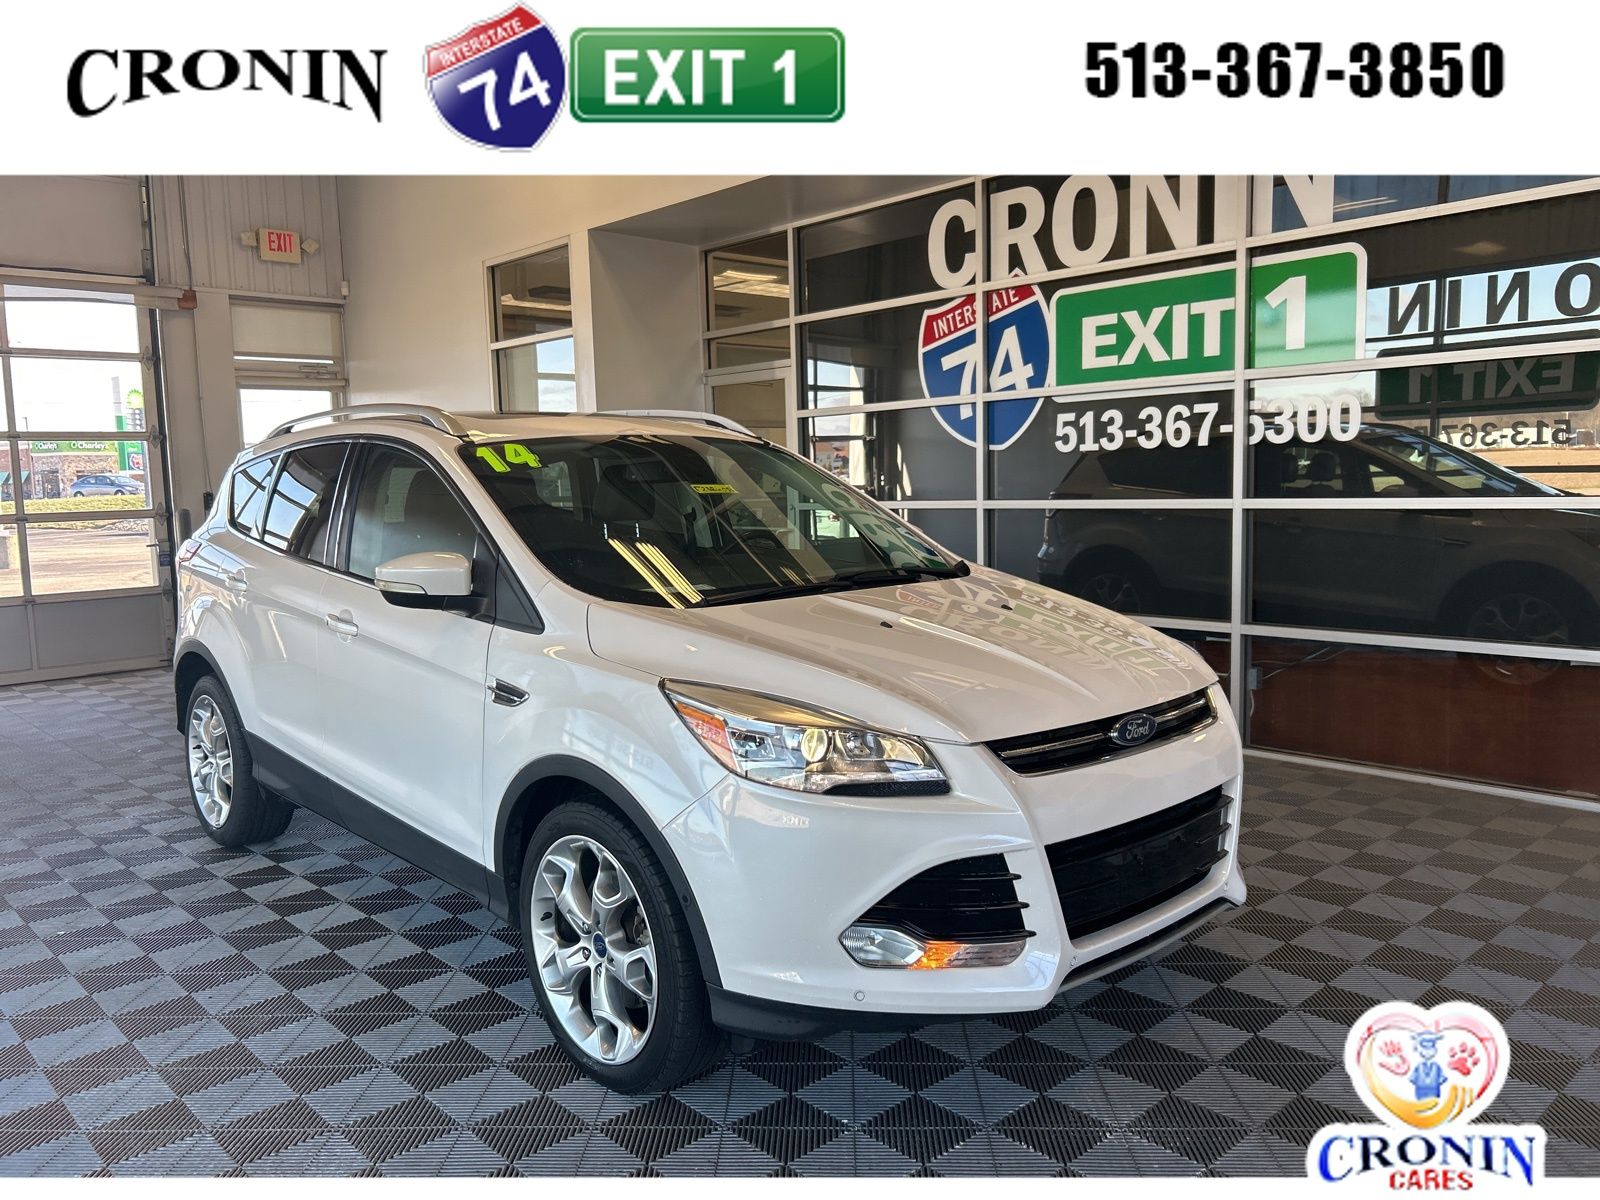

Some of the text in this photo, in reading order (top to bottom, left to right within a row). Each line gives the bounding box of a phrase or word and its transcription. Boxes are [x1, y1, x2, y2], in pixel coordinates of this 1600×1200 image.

[267, 231, 294, 254] EXIT
[1082, 275, 1306, 370] EXIT 1
[940, 325, 1035, 421] 74
[1055, 394, 1362, 454] 513-367-5300
[476, 443, 542, 473] 14
[1125, 719, 1150, 740] Ford
